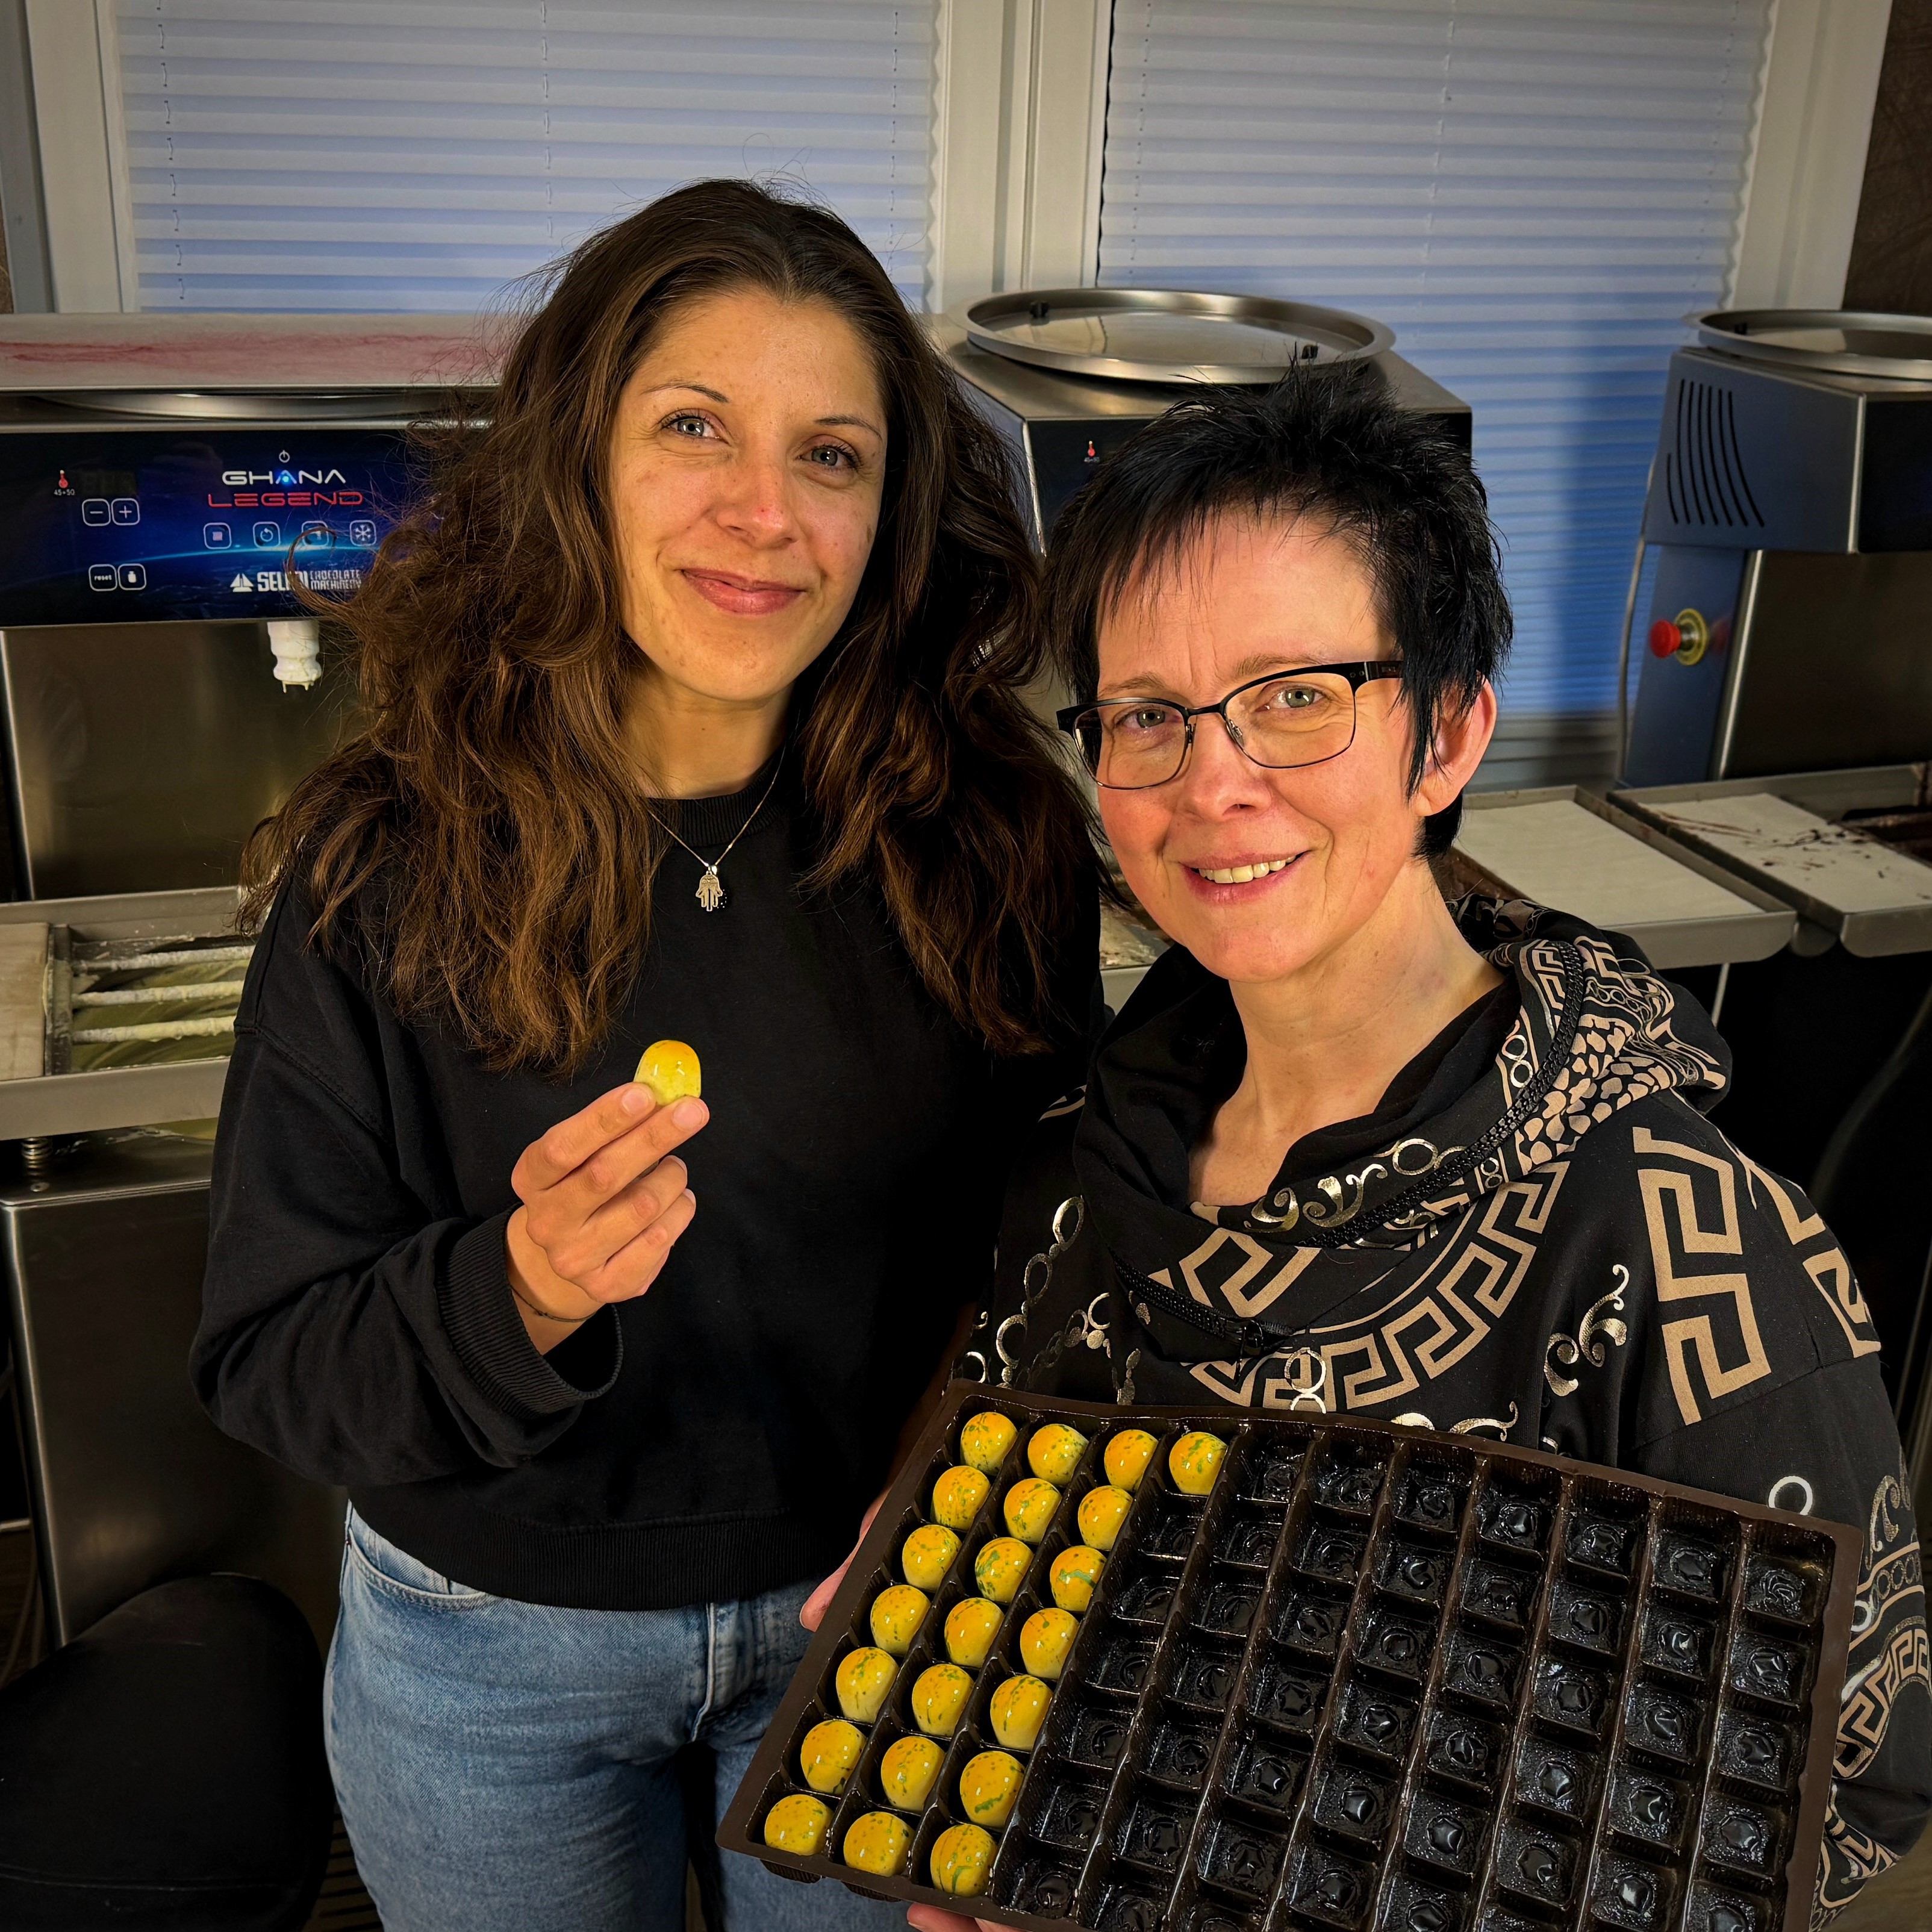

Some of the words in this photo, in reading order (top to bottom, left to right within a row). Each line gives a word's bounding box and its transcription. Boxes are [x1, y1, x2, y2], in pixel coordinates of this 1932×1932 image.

[222, 470, 346, 485] GHANA
[208, 491, 363, 507] LEGEND
[310, 569, 361, 580] CHOCOLATE
